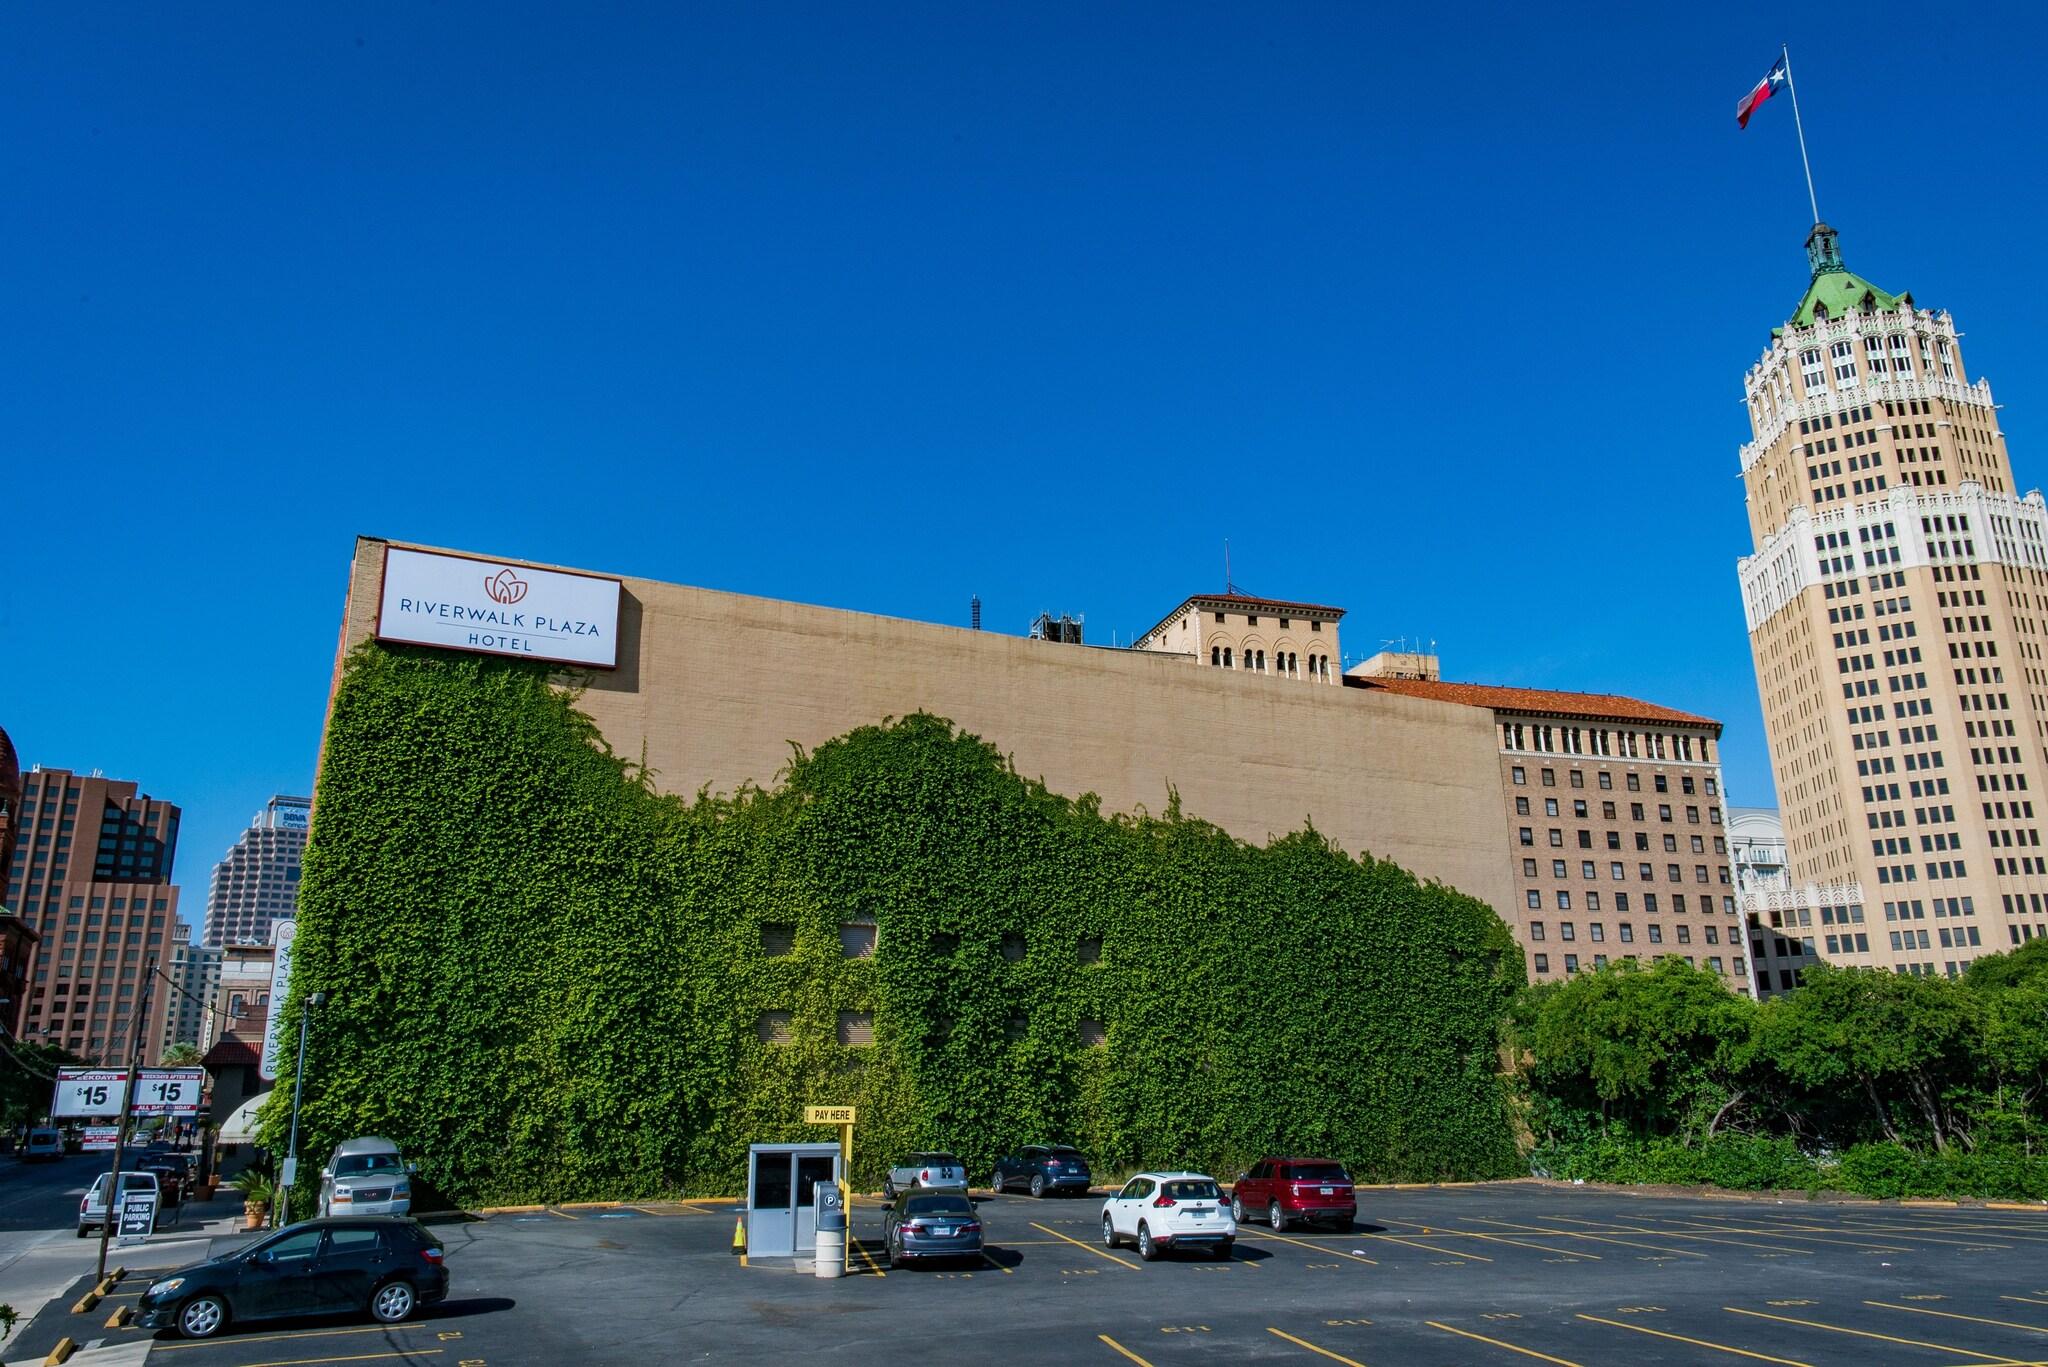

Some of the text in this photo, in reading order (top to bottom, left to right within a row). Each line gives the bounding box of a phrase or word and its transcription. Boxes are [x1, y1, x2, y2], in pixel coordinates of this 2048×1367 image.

[401, 598, 599, 637] RIVERWALK PLAZA
[469, 633, 533, 652] HOTEL
[283, 812, 307, 822] BBVA
[276, 945, 291, 988] PLAZA
[77, 1086, 108, 1106] $15
[152, 1083, 181, 1102] $15
[815, 1110, 829, 1121] PAY
[830, 1110, 851, 1120] HERE
[127, 1203, 150, 1213] PUBLIC
[124, 1212, 150, 1221] PARKING
[1160, 1325, 1214, 1334] 113
[437, 1330, 464, 1341] 12
